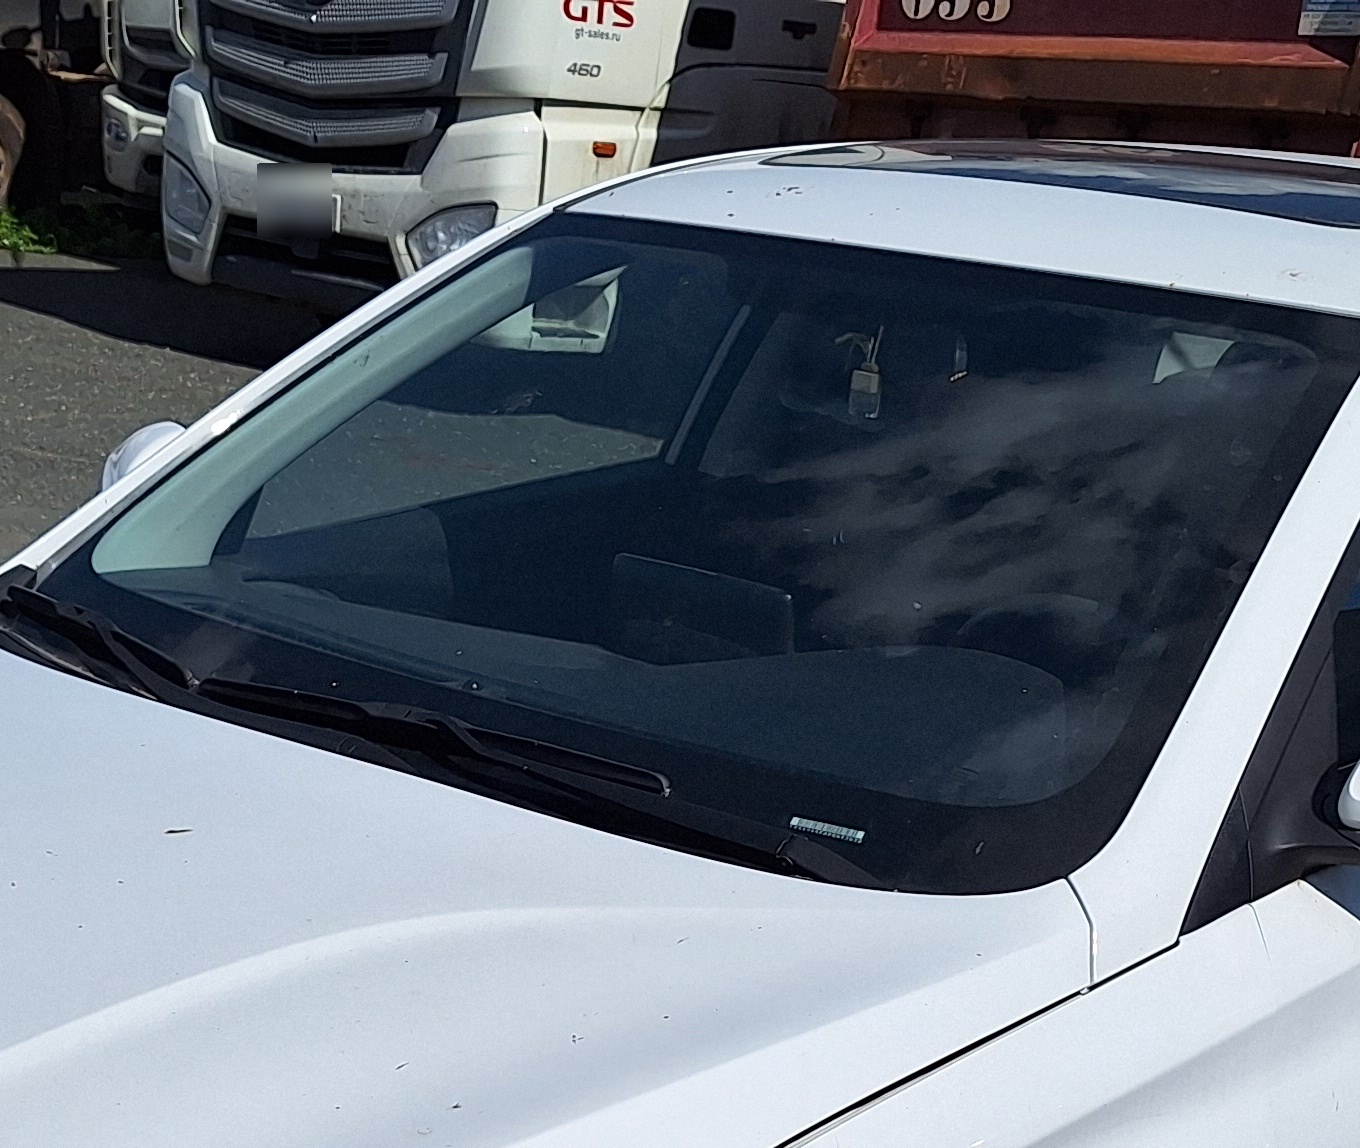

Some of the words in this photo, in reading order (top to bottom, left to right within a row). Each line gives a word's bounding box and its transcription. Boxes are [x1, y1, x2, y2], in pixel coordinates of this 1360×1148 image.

[563, 0, 634, 28] GTS
[575, 27, 621, 41] gt-sales.ru
[566, 62, 602, 77] 460
